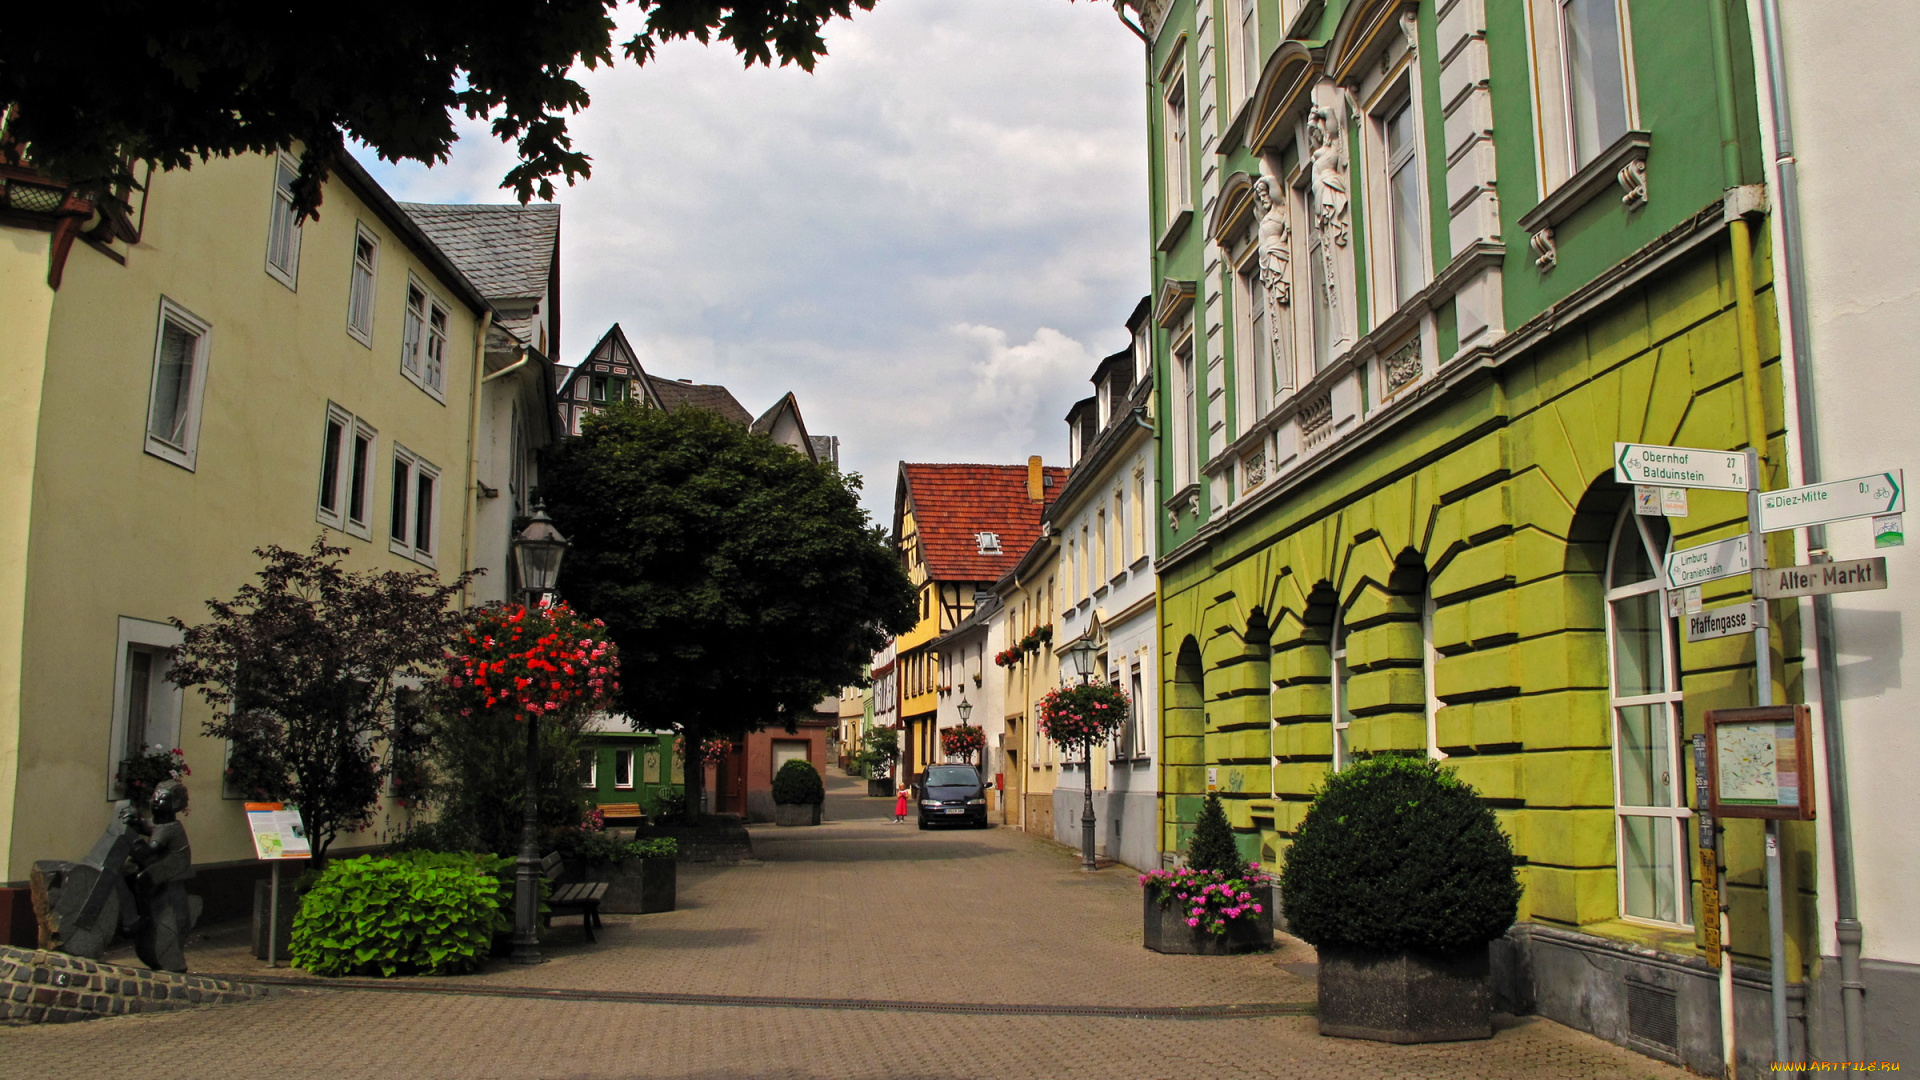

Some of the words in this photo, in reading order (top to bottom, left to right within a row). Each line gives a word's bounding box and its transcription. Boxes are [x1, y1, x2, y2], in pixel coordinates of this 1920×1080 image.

[1642, 450, 1689, 465] Obernhof
[1726, 457, 1736, 469] 27
[1643, 466, 1705, 482] Balduinstein
[1775, 490, 1828, 508] Diez-Mitte
[1681, 552, 1708, 567] Limburg
[1681, 563, 1723, 581] Oranienstein
[1780, 570, 1818, 591] Alter
[1823, 563, 1873, 586] Markt
[1690, 610, 1748, 636] Pfaffengasse
